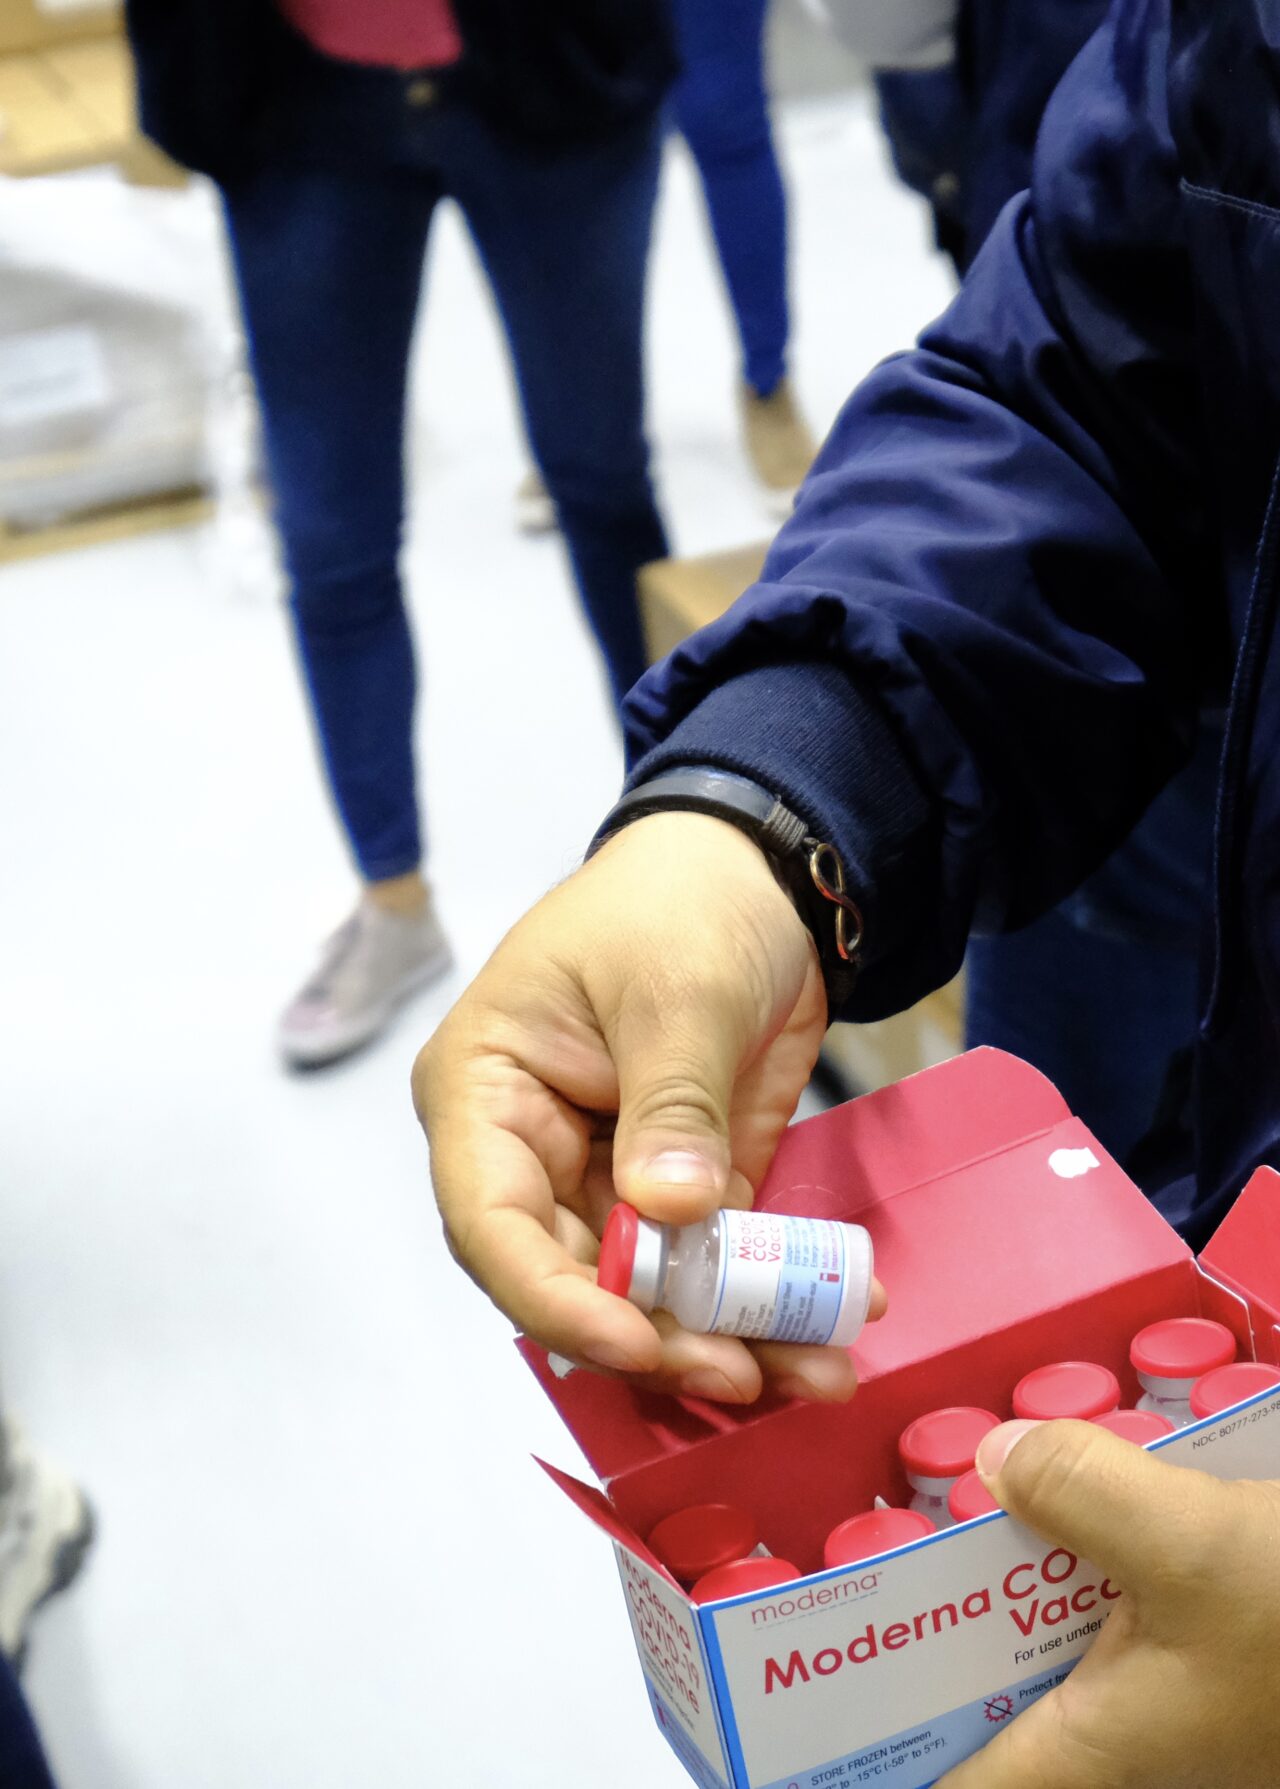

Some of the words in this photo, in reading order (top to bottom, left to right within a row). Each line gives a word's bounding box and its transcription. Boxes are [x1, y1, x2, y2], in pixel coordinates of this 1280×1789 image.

[1192, 1431, 1217, 1450] NDC
[628, 1581, 700, 1690] COVID-19
[765, 1588, 991, 1694] Moderna
[1003, 1548, 1077, 1600] CO
[1009, 1578, 1122, 1637] Vacc
[634, 1612, 700, 1714] Vaccine
[1014, 1647, 1035, 1665] For
[1039, 1636, 1062, 1654] use
[1066, 1618, 1103, 1642] under
[1019, 1678, 1053, 1699] Protect
[811, 1765, 846, 1786] STORE
[848, 1747, 888, 1771] FROZEN
[889, 1730, 932, 1754] between
[912, 1749, 922, 1760] to
